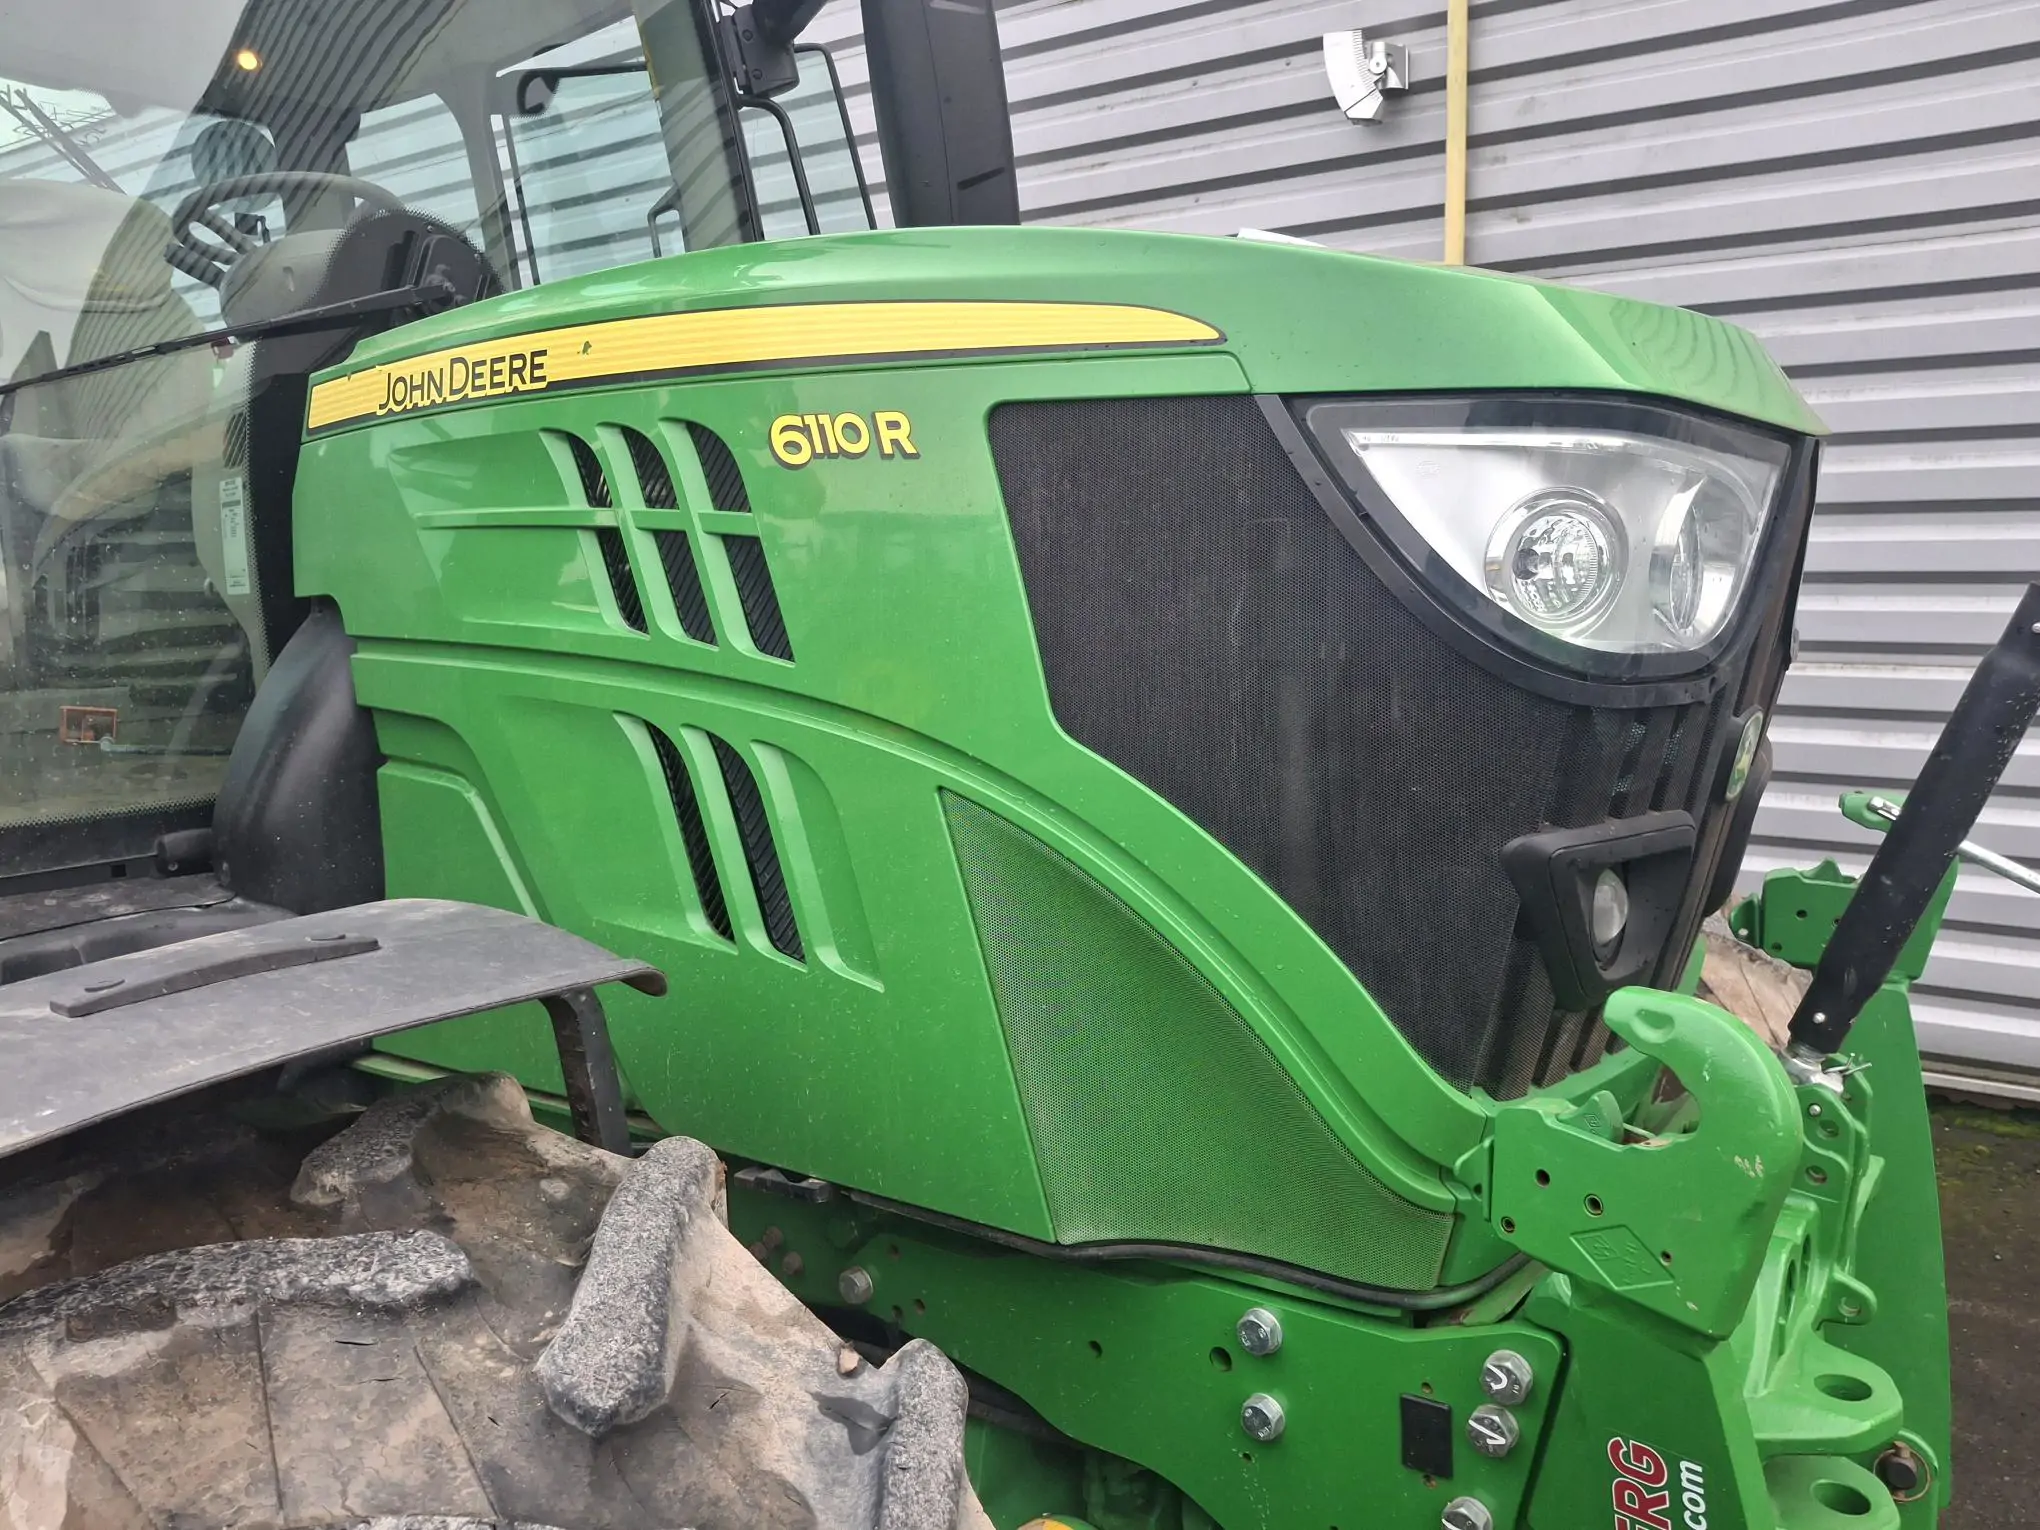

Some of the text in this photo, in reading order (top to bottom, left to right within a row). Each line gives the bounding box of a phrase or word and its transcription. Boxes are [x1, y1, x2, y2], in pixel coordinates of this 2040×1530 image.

[378, 349, 548, 411] JOHN DEERE
[769, 410, 921, 471] 6110 R
